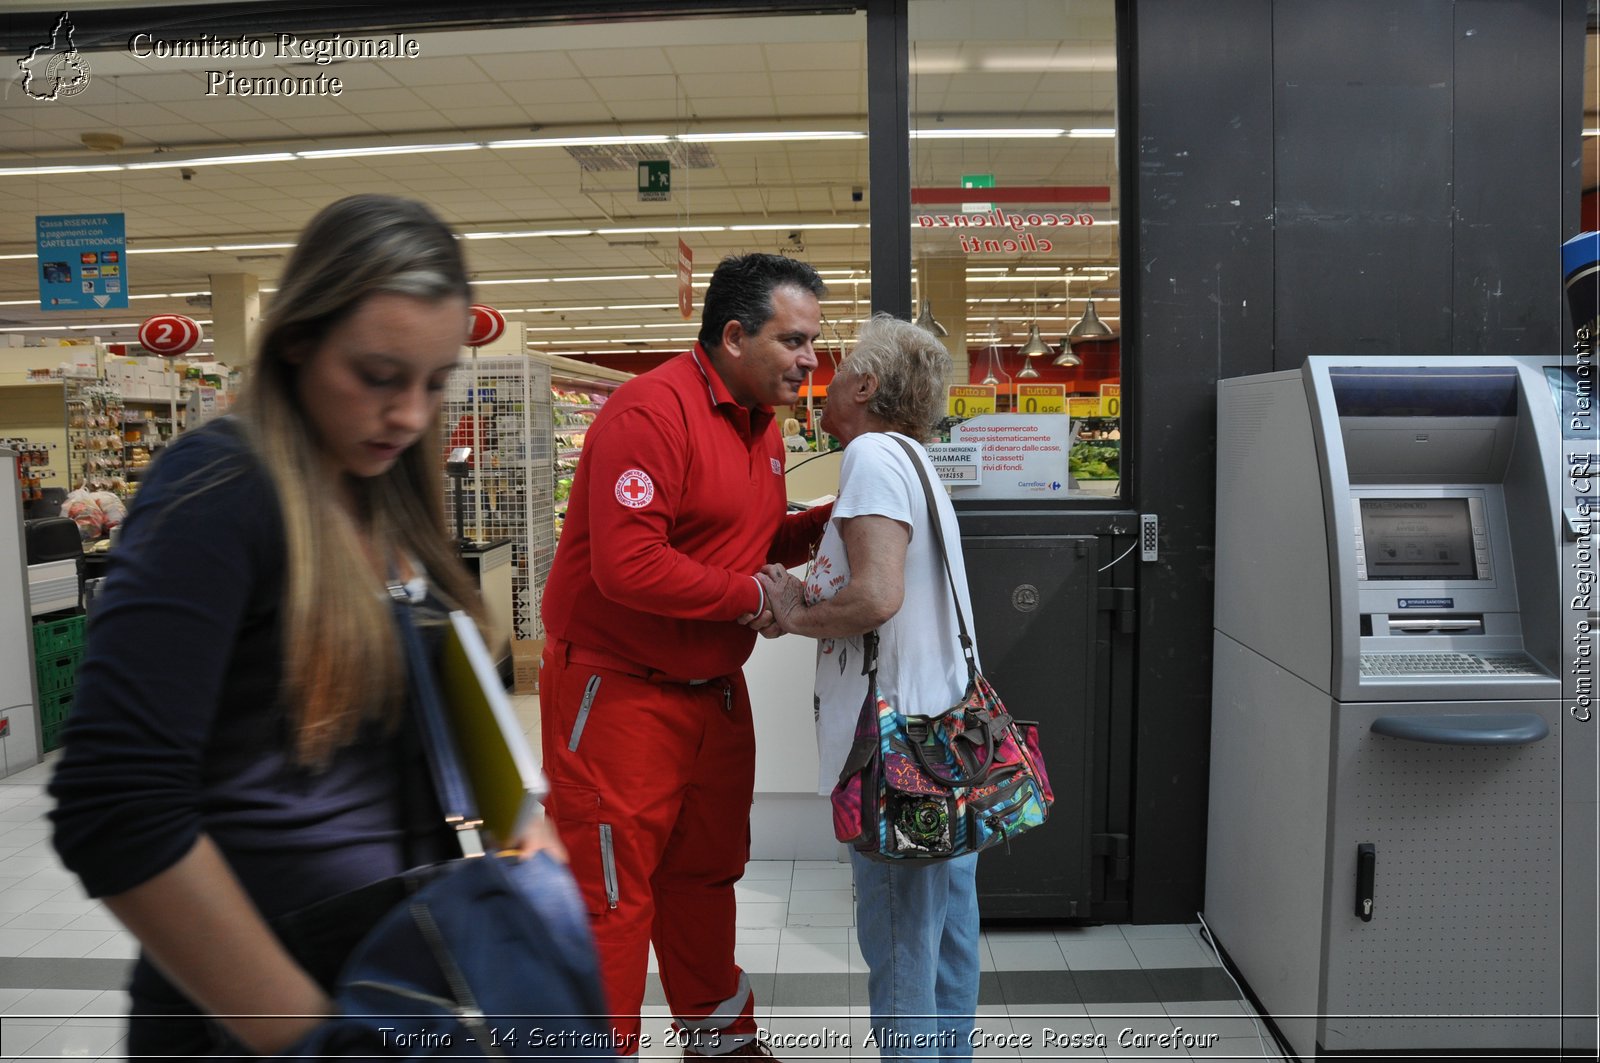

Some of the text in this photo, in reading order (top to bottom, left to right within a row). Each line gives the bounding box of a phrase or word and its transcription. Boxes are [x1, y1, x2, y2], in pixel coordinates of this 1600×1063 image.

[40, 217, 109, 228] Cassa RISERVATA
[46, 229, 87, 239] pagamenti
[41, 237, 124, 248] CARTE ELETTRONICHE
[155, 323, 174, 344] 2
[955, 388, 979, 396] tutto
[1026, 387, 1050, 395] tutto
[987, 425, 1039, 434] supermercato
